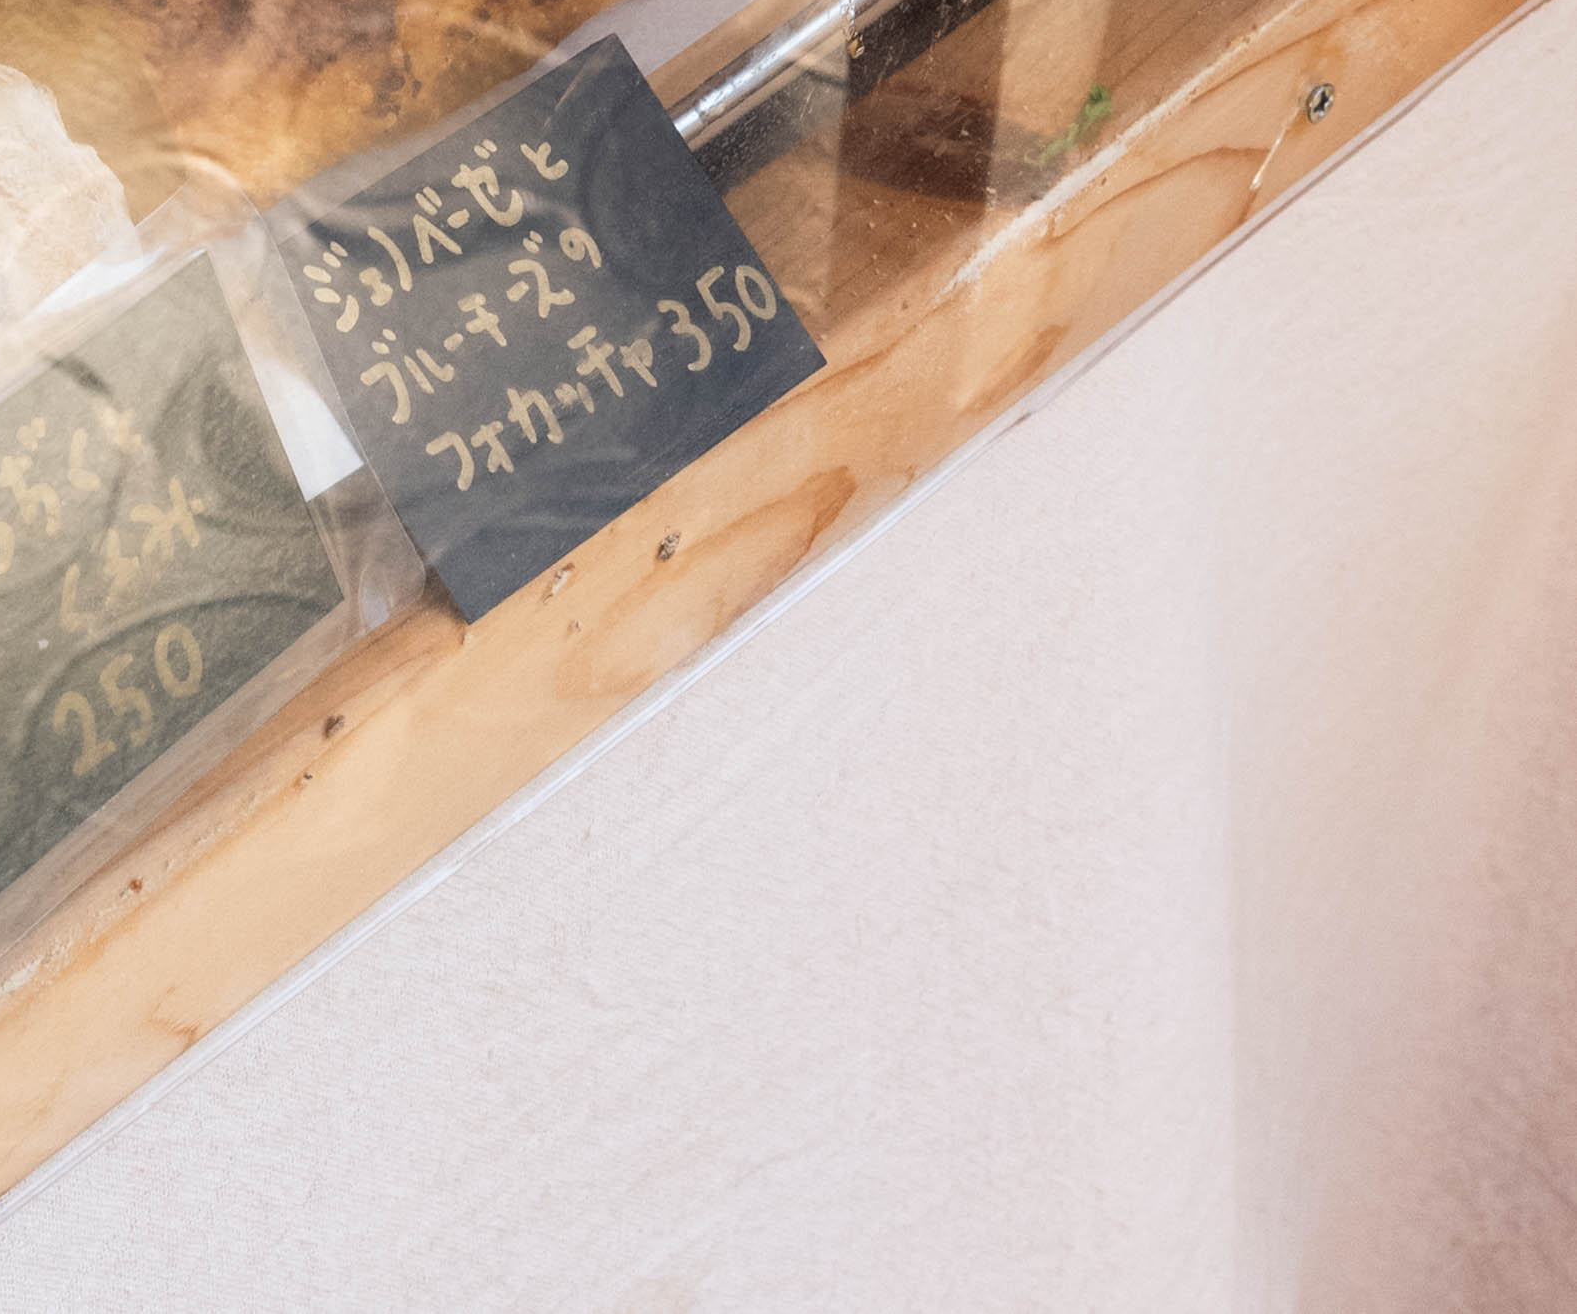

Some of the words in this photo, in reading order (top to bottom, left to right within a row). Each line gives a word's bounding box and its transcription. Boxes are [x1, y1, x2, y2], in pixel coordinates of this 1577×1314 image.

[360, 227, 601, 424] ブルーチーズの
[658, 265, 777, 370] 350
[53, 623, 203, 775] 250
